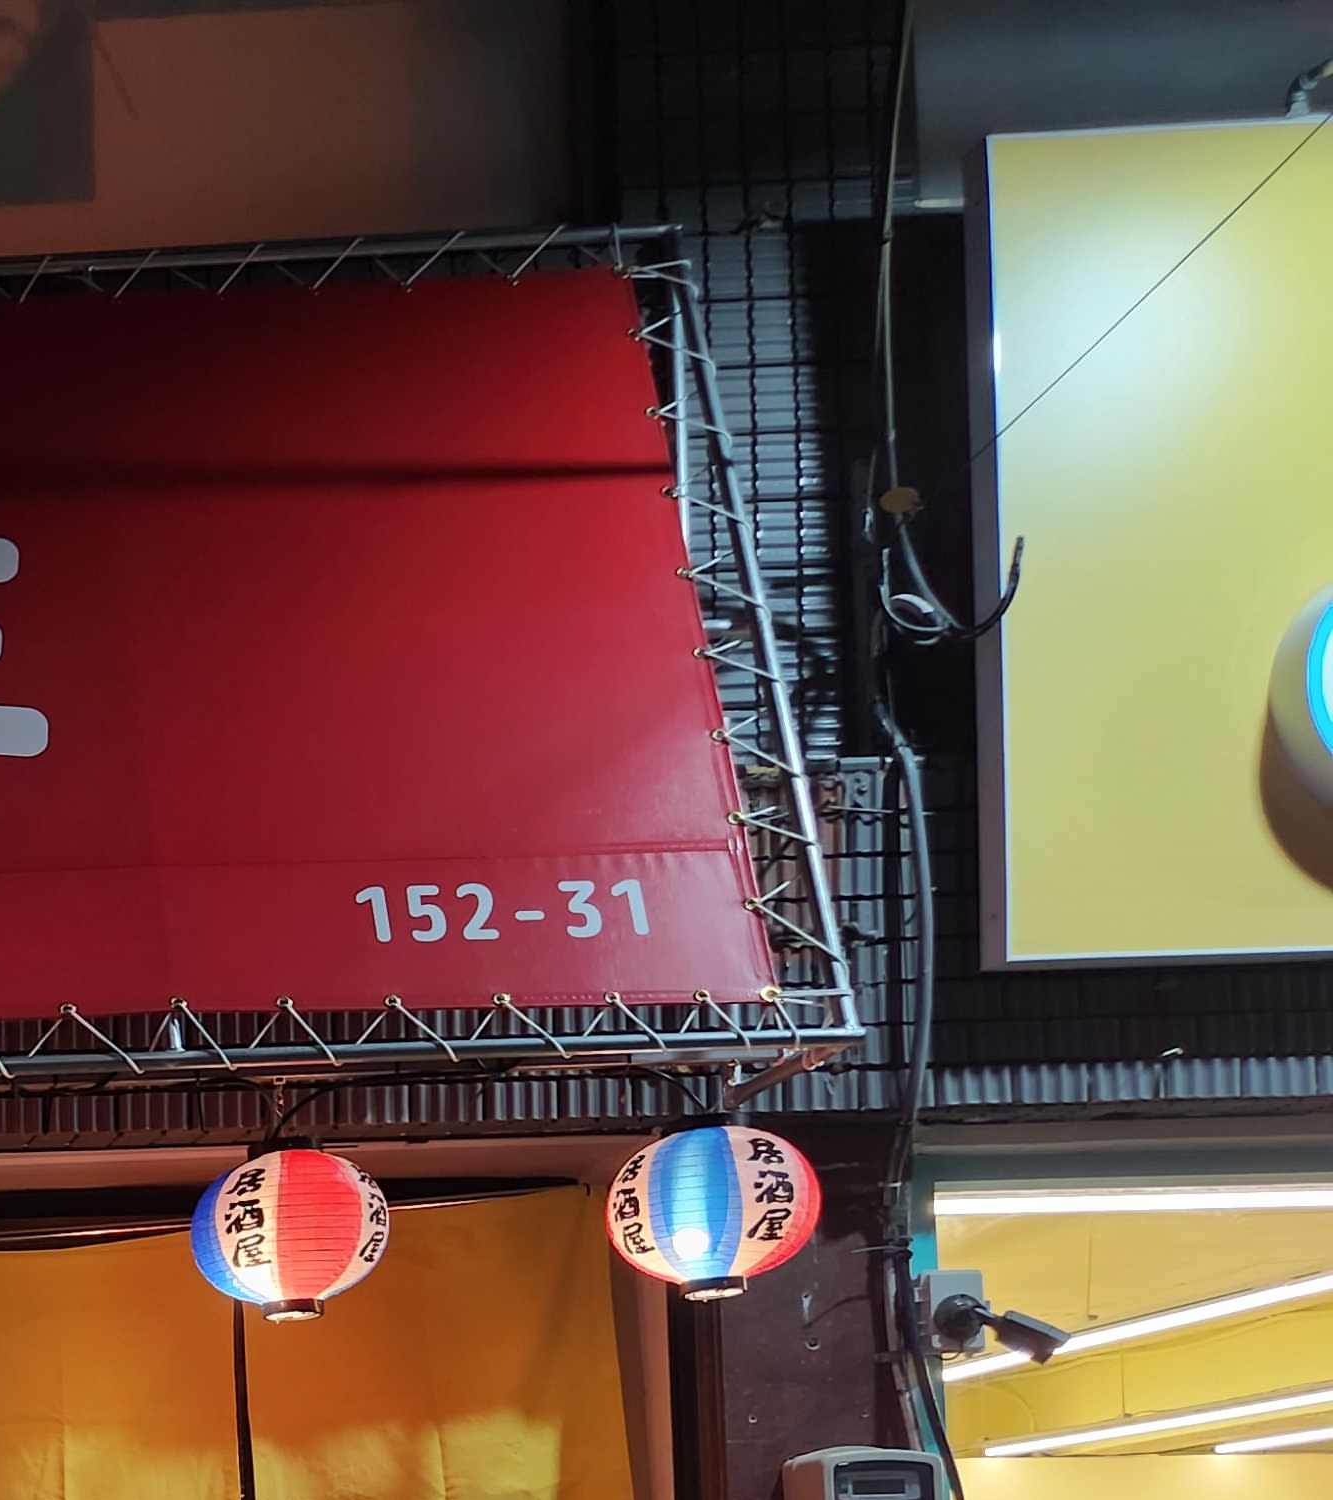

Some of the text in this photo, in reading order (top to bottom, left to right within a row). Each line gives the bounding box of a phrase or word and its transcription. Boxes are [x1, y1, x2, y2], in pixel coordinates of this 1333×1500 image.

[355, 879, 650, 942] 152-31
[224, 1168, 272, 1268] 居酒屋
[612, 1154, 655, 1255] 居酒屋
[746, 1138, 794, 1241] 居酒屋
